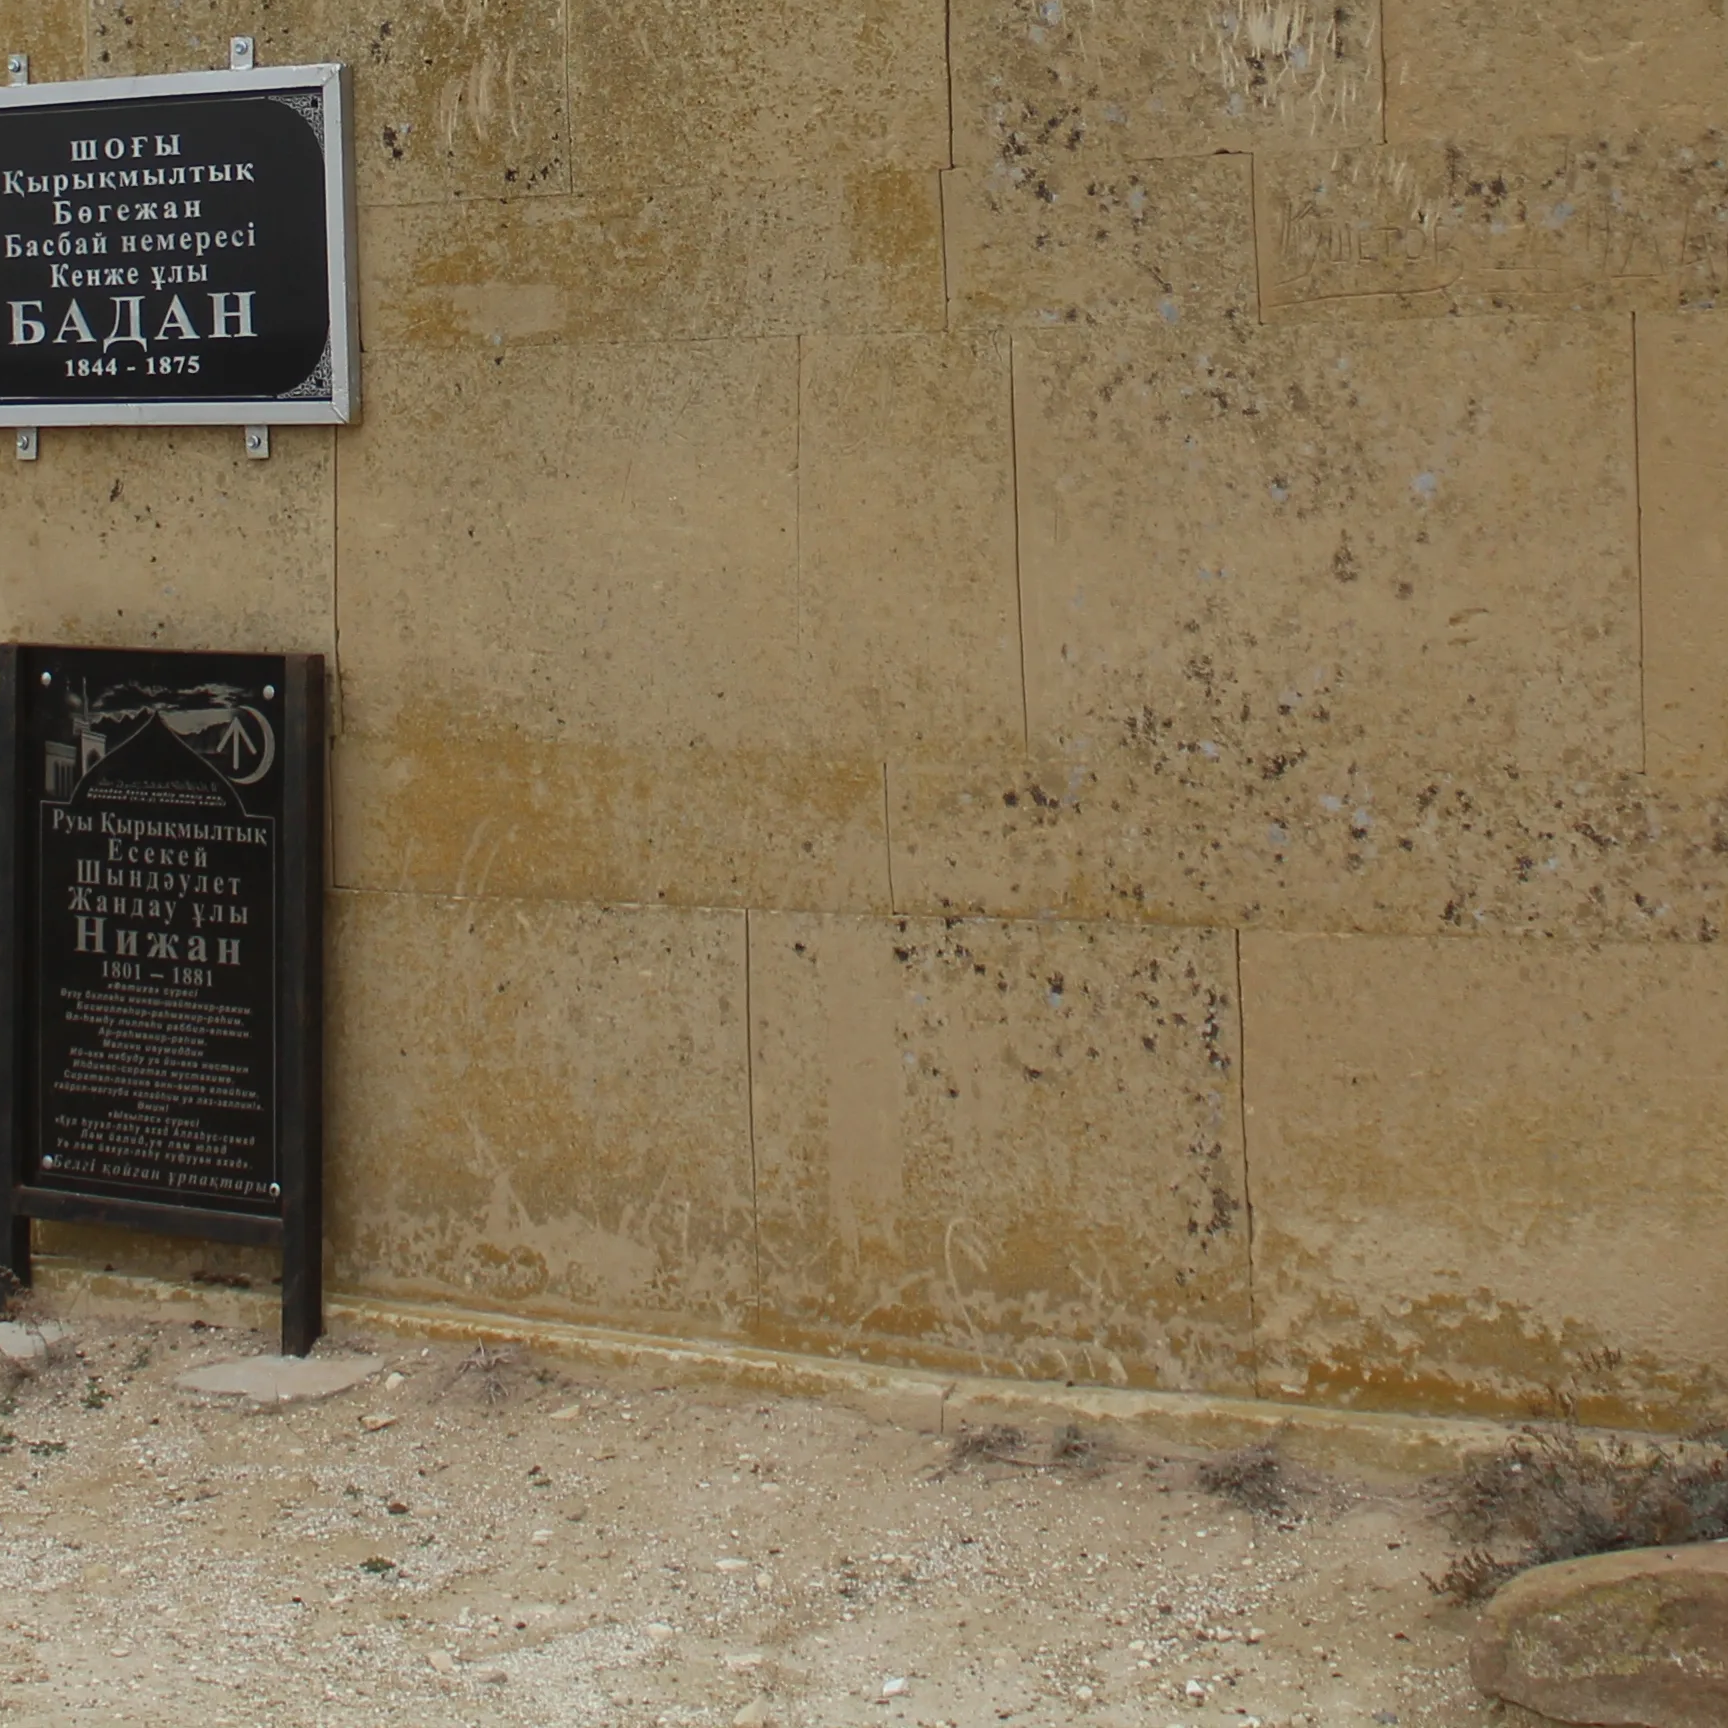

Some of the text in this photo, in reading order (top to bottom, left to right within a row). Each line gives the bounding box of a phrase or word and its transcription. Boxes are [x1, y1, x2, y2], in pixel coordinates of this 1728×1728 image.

[3, 162, 255, 198] Қырықмылтық
[53, 200, 202, 225] Бөгежан
[4, 222, 257, 258] Басбай немересі
[50, 261, 208, 291] Кенже ұлы
[6, 291, 258, 353] БАДАН
[65, 358, 118, 377] 1844
[146, 355, 201, 374] 1875
[52, 808, 268, 846] Руы Қырықмылтық
[108, 838, 208, 868] Есекей
[77, 859, 241, 898] Шындәулет
[68, 886, 248, 928] Жандау ұлы
[74, 915, 241, 966] Нижан
[101, 960, 141, 980] 1801
[172, 967, 213, 987] 1881
